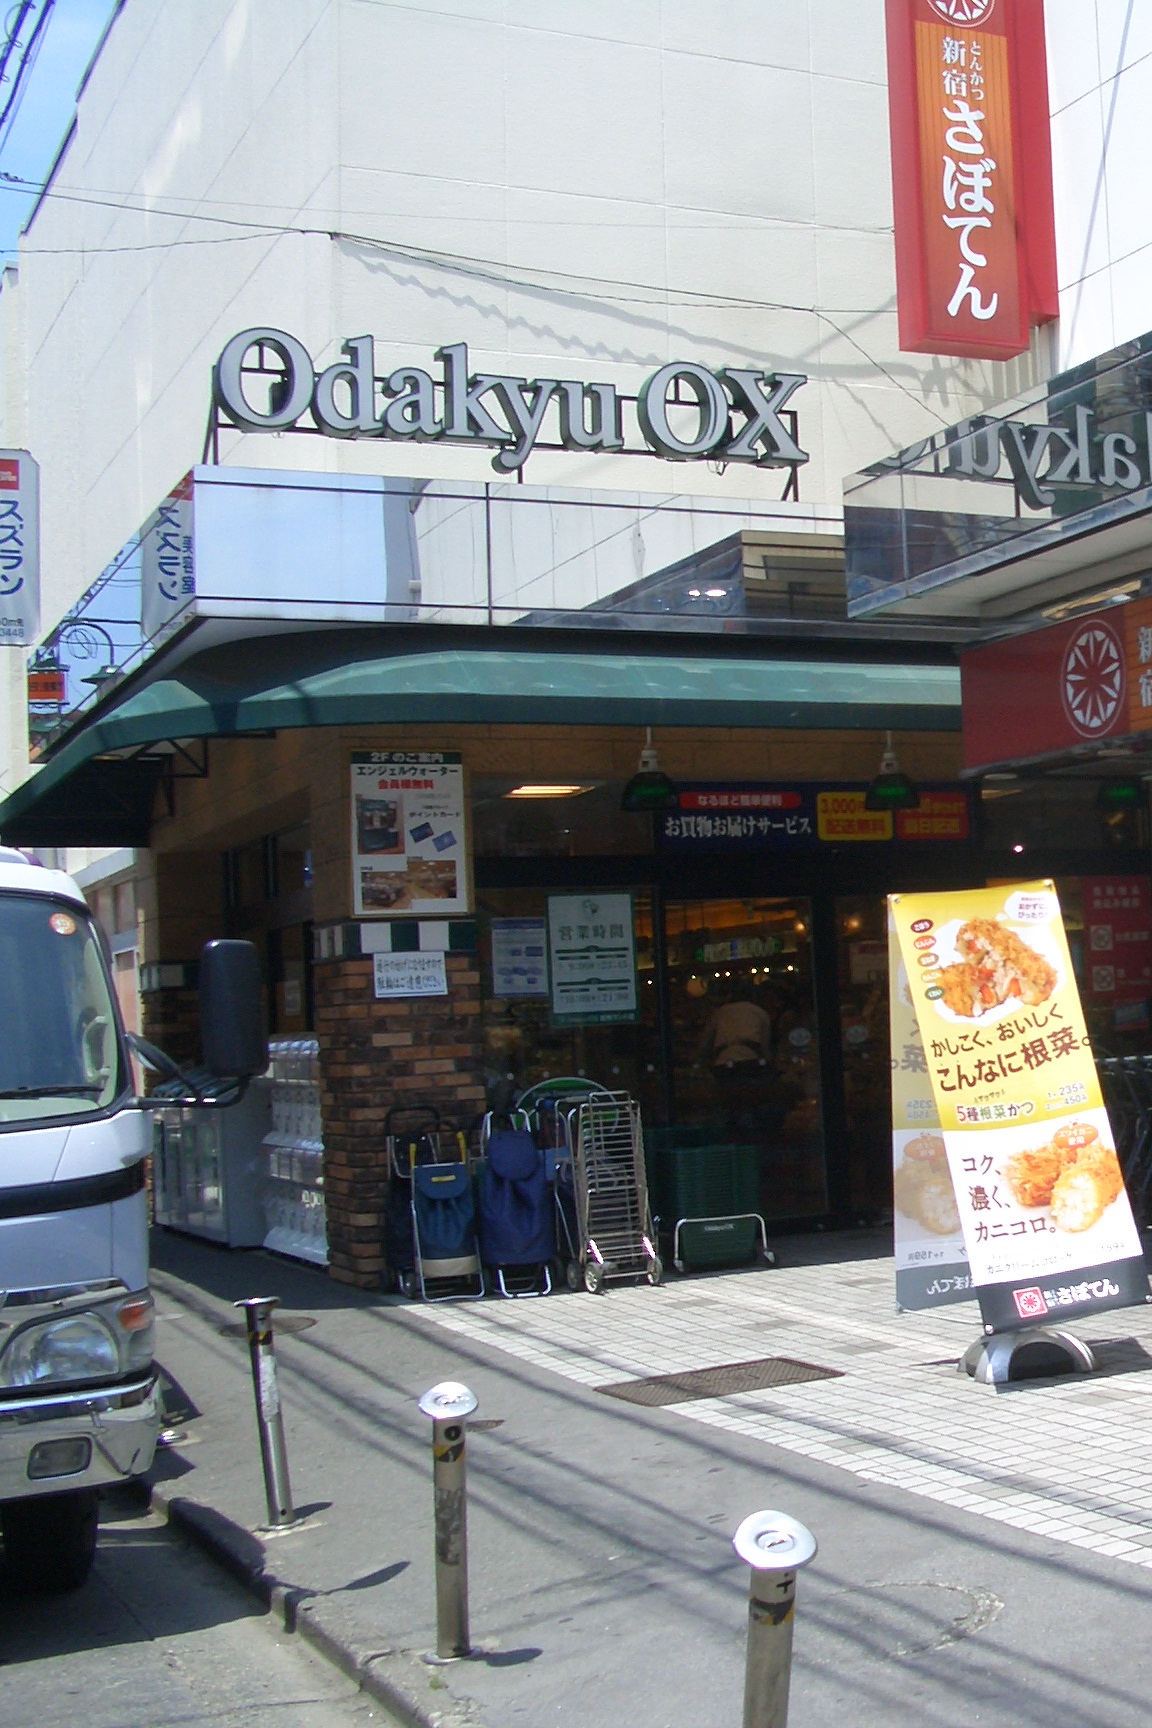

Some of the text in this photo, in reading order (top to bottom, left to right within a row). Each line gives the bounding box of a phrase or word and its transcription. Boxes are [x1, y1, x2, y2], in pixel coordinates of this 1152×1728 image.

[942, 36, 968, 98] 新宿
[968, 41, 985, 101] とんかつ
[942, 100, 999, 320] さぼてん
[216, 327, 810, 472] Odakyu OX
[664, 815, 813, 839] お買物お届けサービス
[558, 924, 624, 941] 営業時間
[930, 1003, 1064, 1059] かしこく、おいしく
[936, 1025, 1092, 1092] こんなに根菜。
[956, 1101, 1034, 1122] 5種根菜かつ
[961, 1153, 1002, 1176] コク、
[967, 1185, 1012, 1211] 濃く、
[973, 1215, 1057, 1244] カニコロ。
[1057, 1278, 1120, 1304] さぼてん
